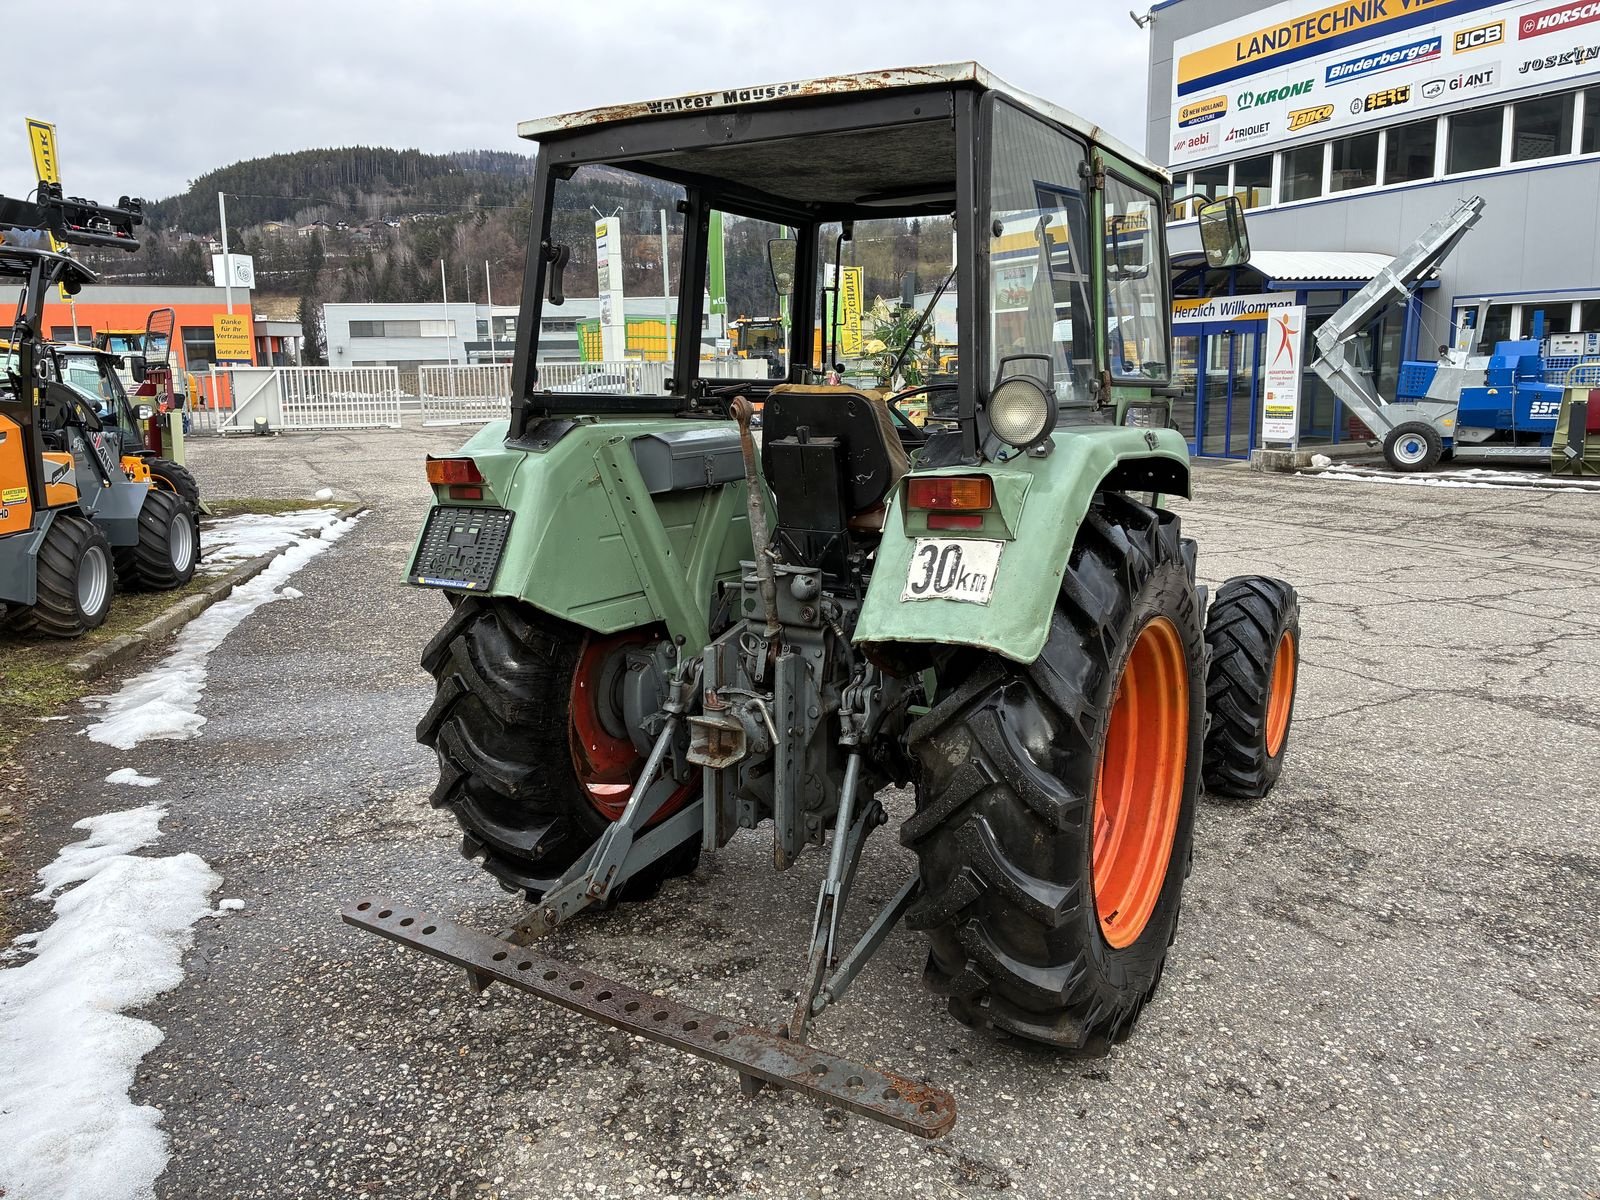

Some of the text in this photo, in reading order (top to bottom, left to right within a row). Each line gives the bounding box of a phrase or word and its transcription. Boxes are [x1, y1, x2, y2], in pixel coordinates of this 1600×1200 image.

[1536, 2, 1600, 30] HORSCH
[1236, 0, 1387, 61] LANDTECHNIK
[1456, 24, 1502, 49] JCB
[1329, 41, 1438, 79] Binderberger
[647, 95, 713, 113] Walter
[1254, 79, 1315, 106] KRONE
[1189, 101, 1224, 116] NEW HOLLAND
[1288, 104, 1334, 128] Tanco
[1188, 132, 1209, 147] aebi
[1174, 302, 1215, 318] Herzlich
